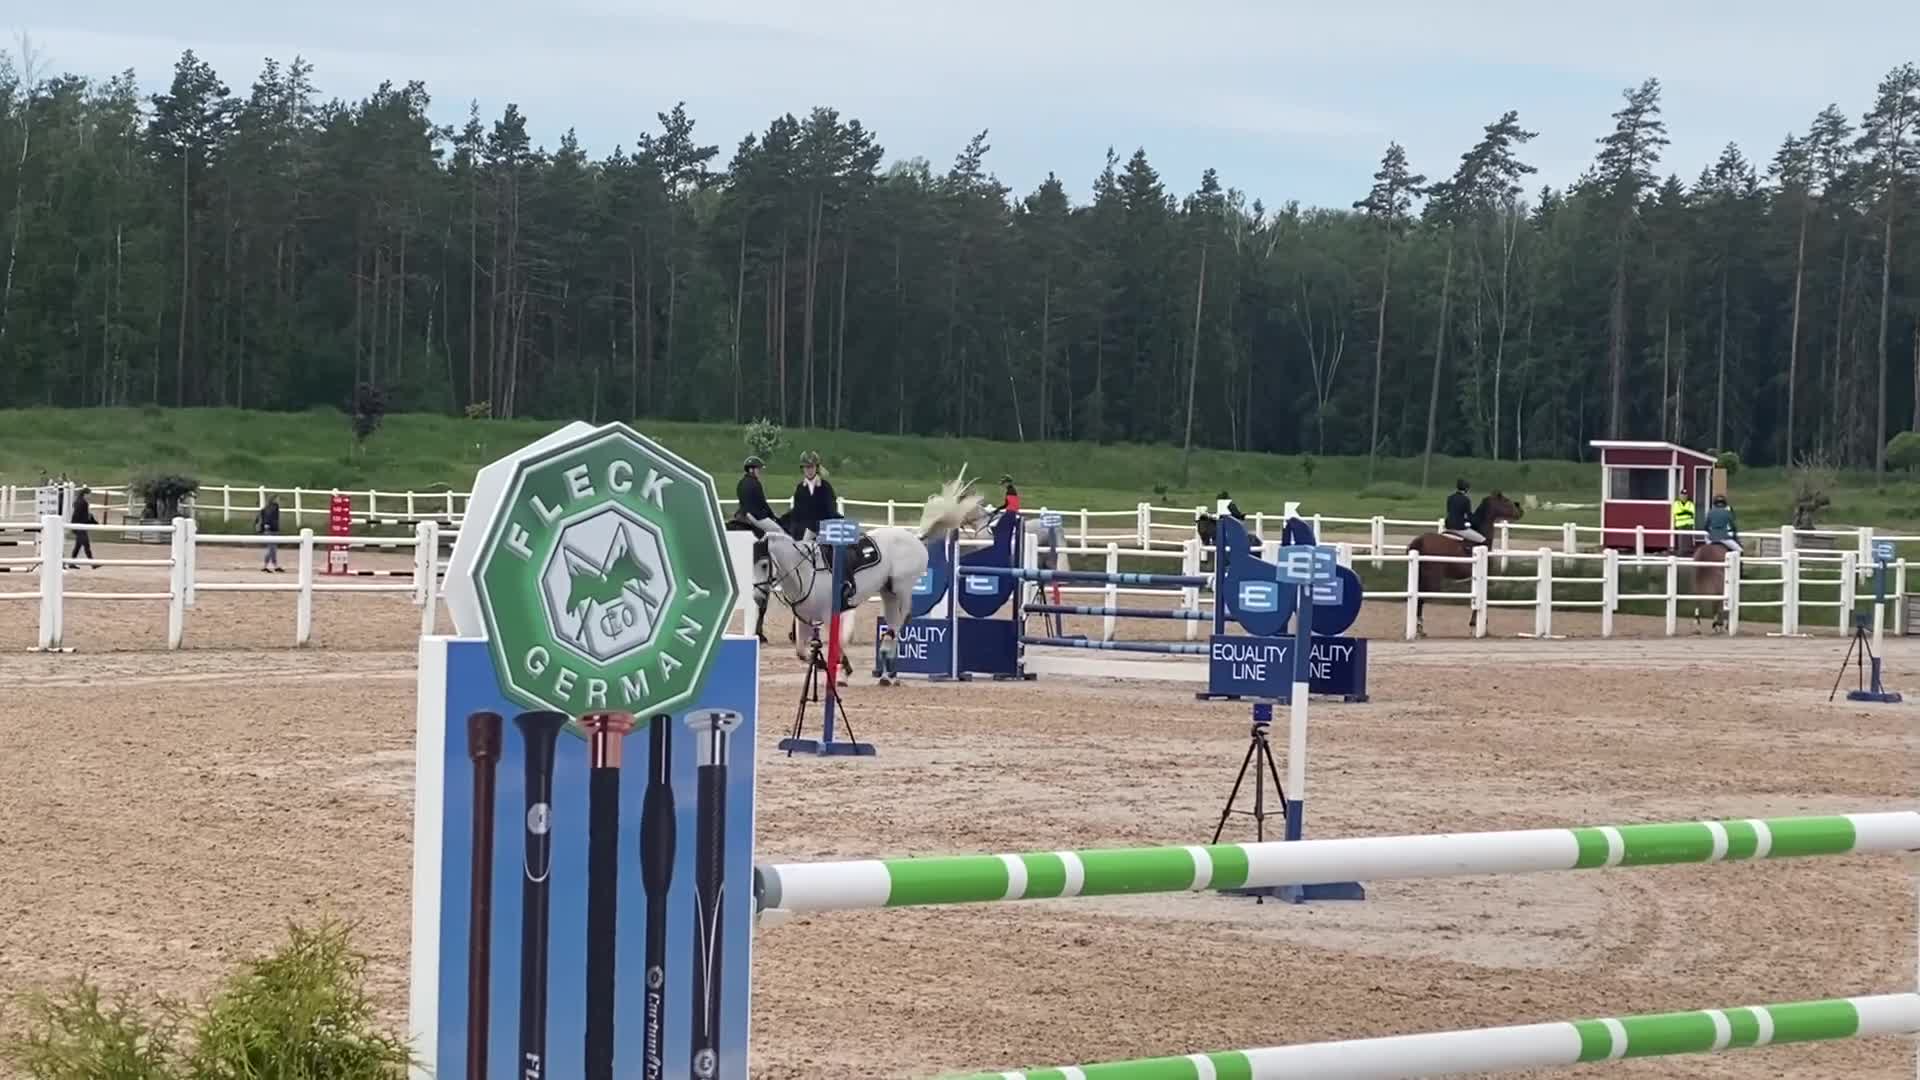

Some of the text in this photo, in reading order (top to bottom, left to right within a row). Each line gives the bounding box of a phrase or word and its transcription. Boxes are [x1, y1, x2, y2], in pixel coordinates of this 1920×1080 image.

[504, 460, 674, 561] FLECK
[880, 625, 947, 642] EUALITY
[525, 578, 711, 708] GERMANY
[897, 643, 928, 660] LINE
[1212, 643, 1287, 663] EQUALITY
[1309, 644, 1353, 662] ALITY
[1232, 663, 1266, 681] LINE
[1309, 662, 1332, 679] NE
